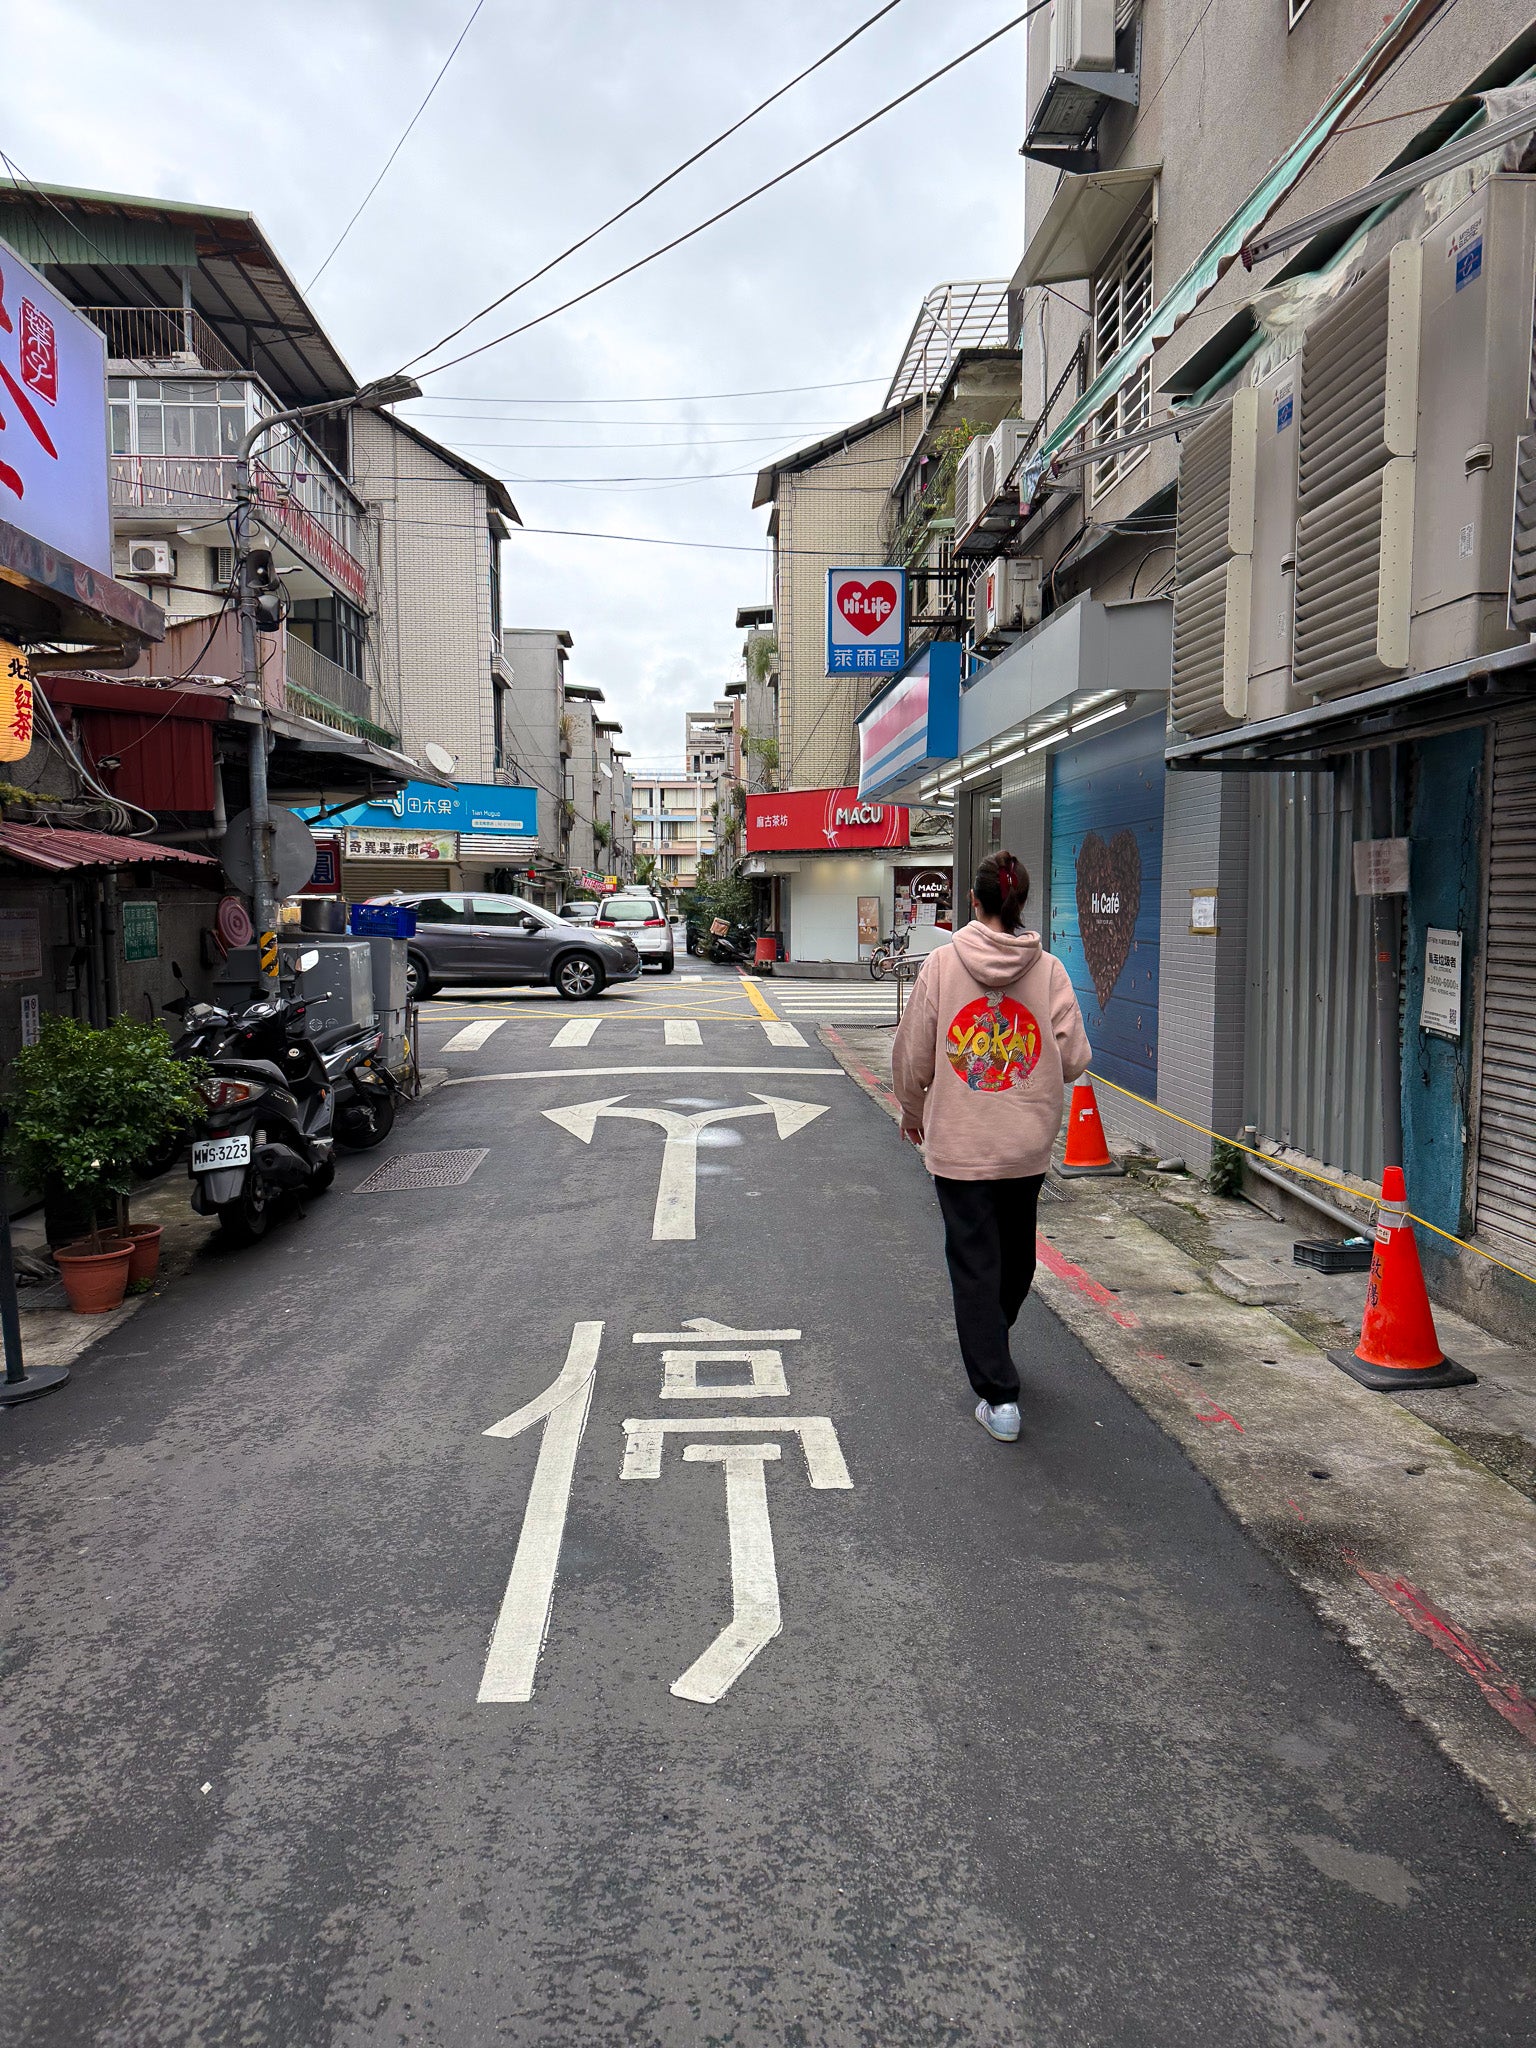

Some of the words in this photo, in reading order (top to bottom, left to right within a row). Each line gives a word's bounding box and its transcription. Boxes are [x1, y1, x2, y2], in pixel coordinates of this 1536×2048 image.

[843, 592, 892, 622] Hi-Life
[833, 649, 900, 667] 萊爾富
[8, 683, 33, 741] 紅茶
[407, 797, 452, 815] 田木果
[756, 814, 788, 828] 麻古茶坊
[1100, 891, 1120, 914] Café
[477, 1317, 854, 1704] 停
